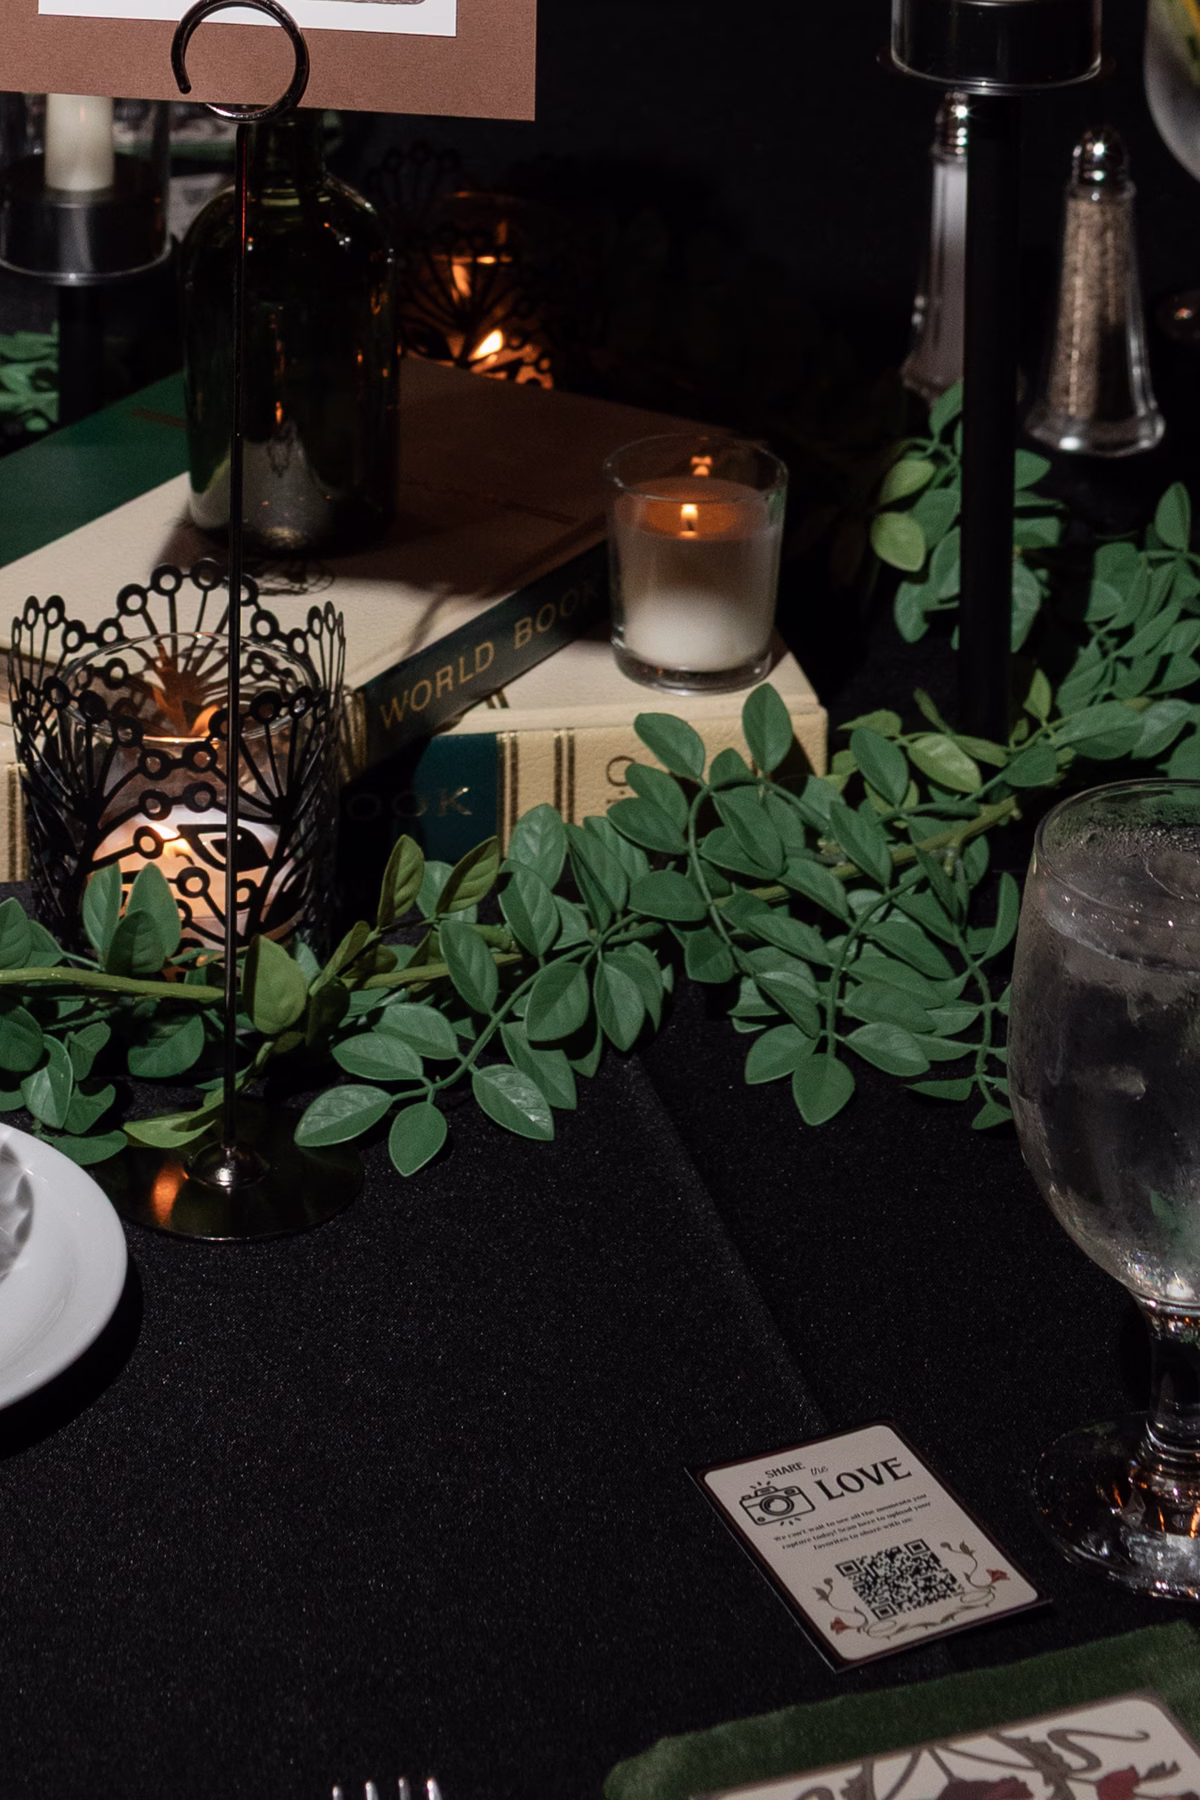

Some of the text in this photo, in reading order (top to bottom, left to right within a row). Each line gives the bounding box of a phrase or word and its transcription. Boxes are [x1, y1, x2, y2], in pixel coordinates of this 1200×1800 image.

[378, 573, 601, 730] WORLD BOOK
[344, 786, 473, 821] OOK
[764, 1461, 806, 1479] SHARE
[810, 1465, 829, 1476] the
[814, 1457, 913, 1501] LOVE
